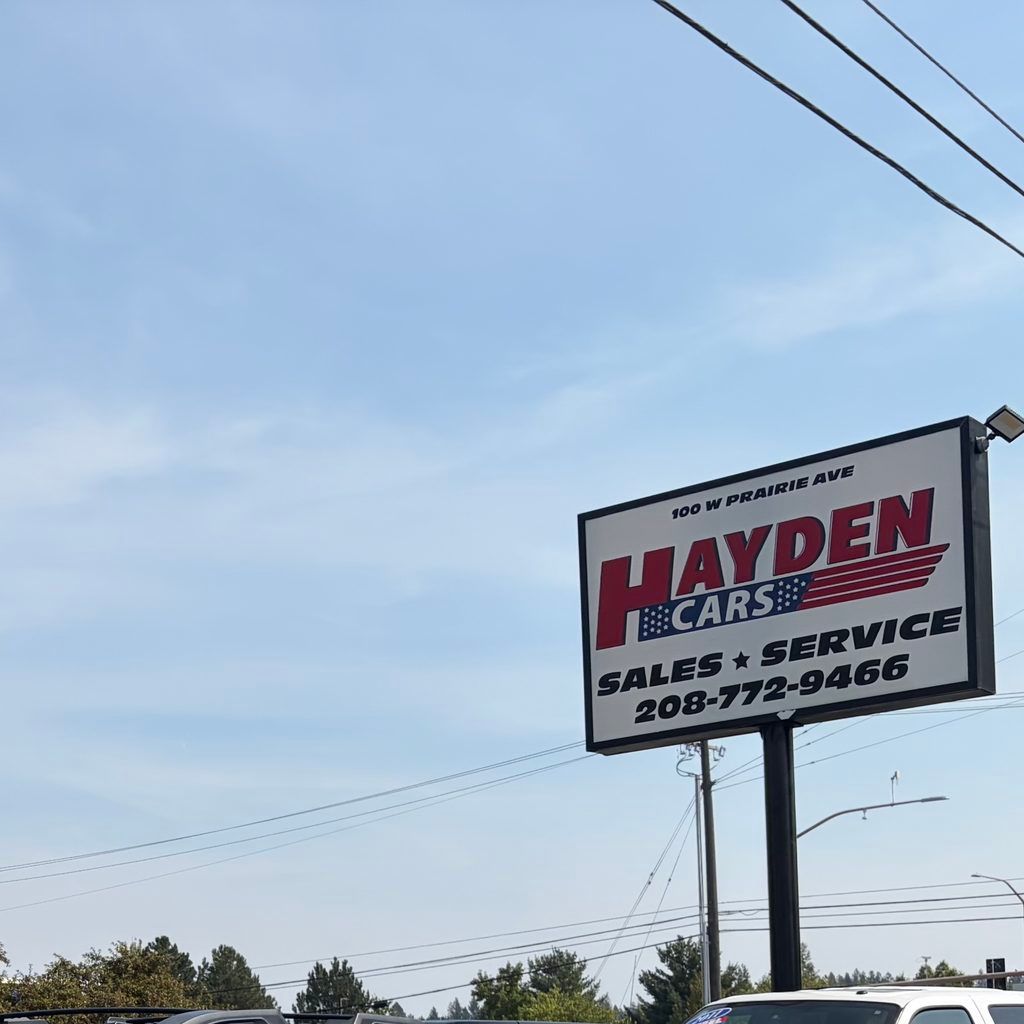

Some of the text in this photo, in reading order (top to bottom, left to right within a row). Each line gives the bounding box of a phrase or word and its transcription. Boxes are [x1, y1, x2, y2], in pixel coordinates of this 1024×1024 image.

[671, 465, 855, 520] 100 W PRAIRIE AVE
[596, 487, 935, 651] HAYDEN
[671, 583, 776, 631] CARS
[597, 606, 963, 696] SALES SERVICE
[634, 653, 911, 724] 208-772-9466
